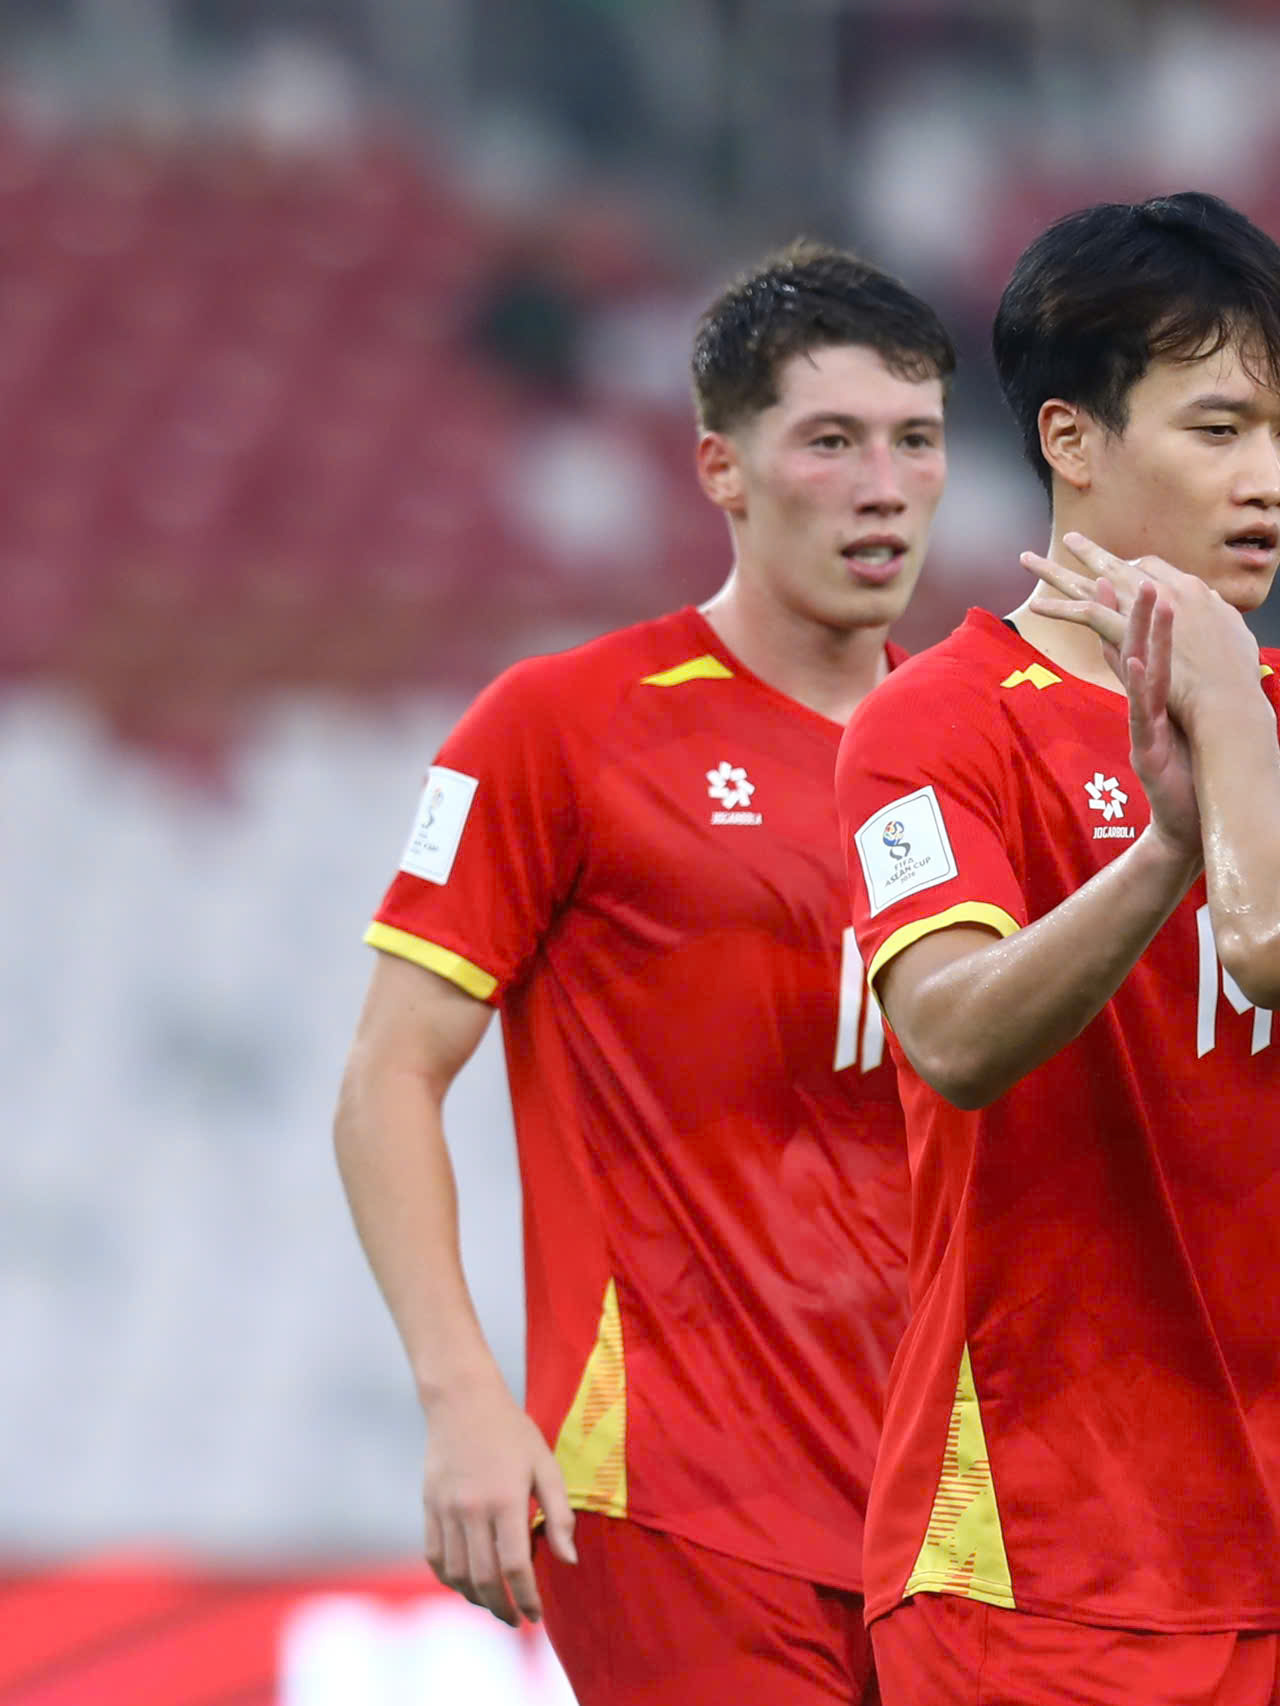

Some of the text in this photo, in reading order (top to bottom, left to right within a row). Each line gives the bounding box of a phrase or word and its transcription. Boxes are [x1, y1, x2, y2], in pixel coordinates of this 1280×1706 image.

[884, 856, 931, 888] ASEAN CUP
[894, 857, 915, 871] FIFA
